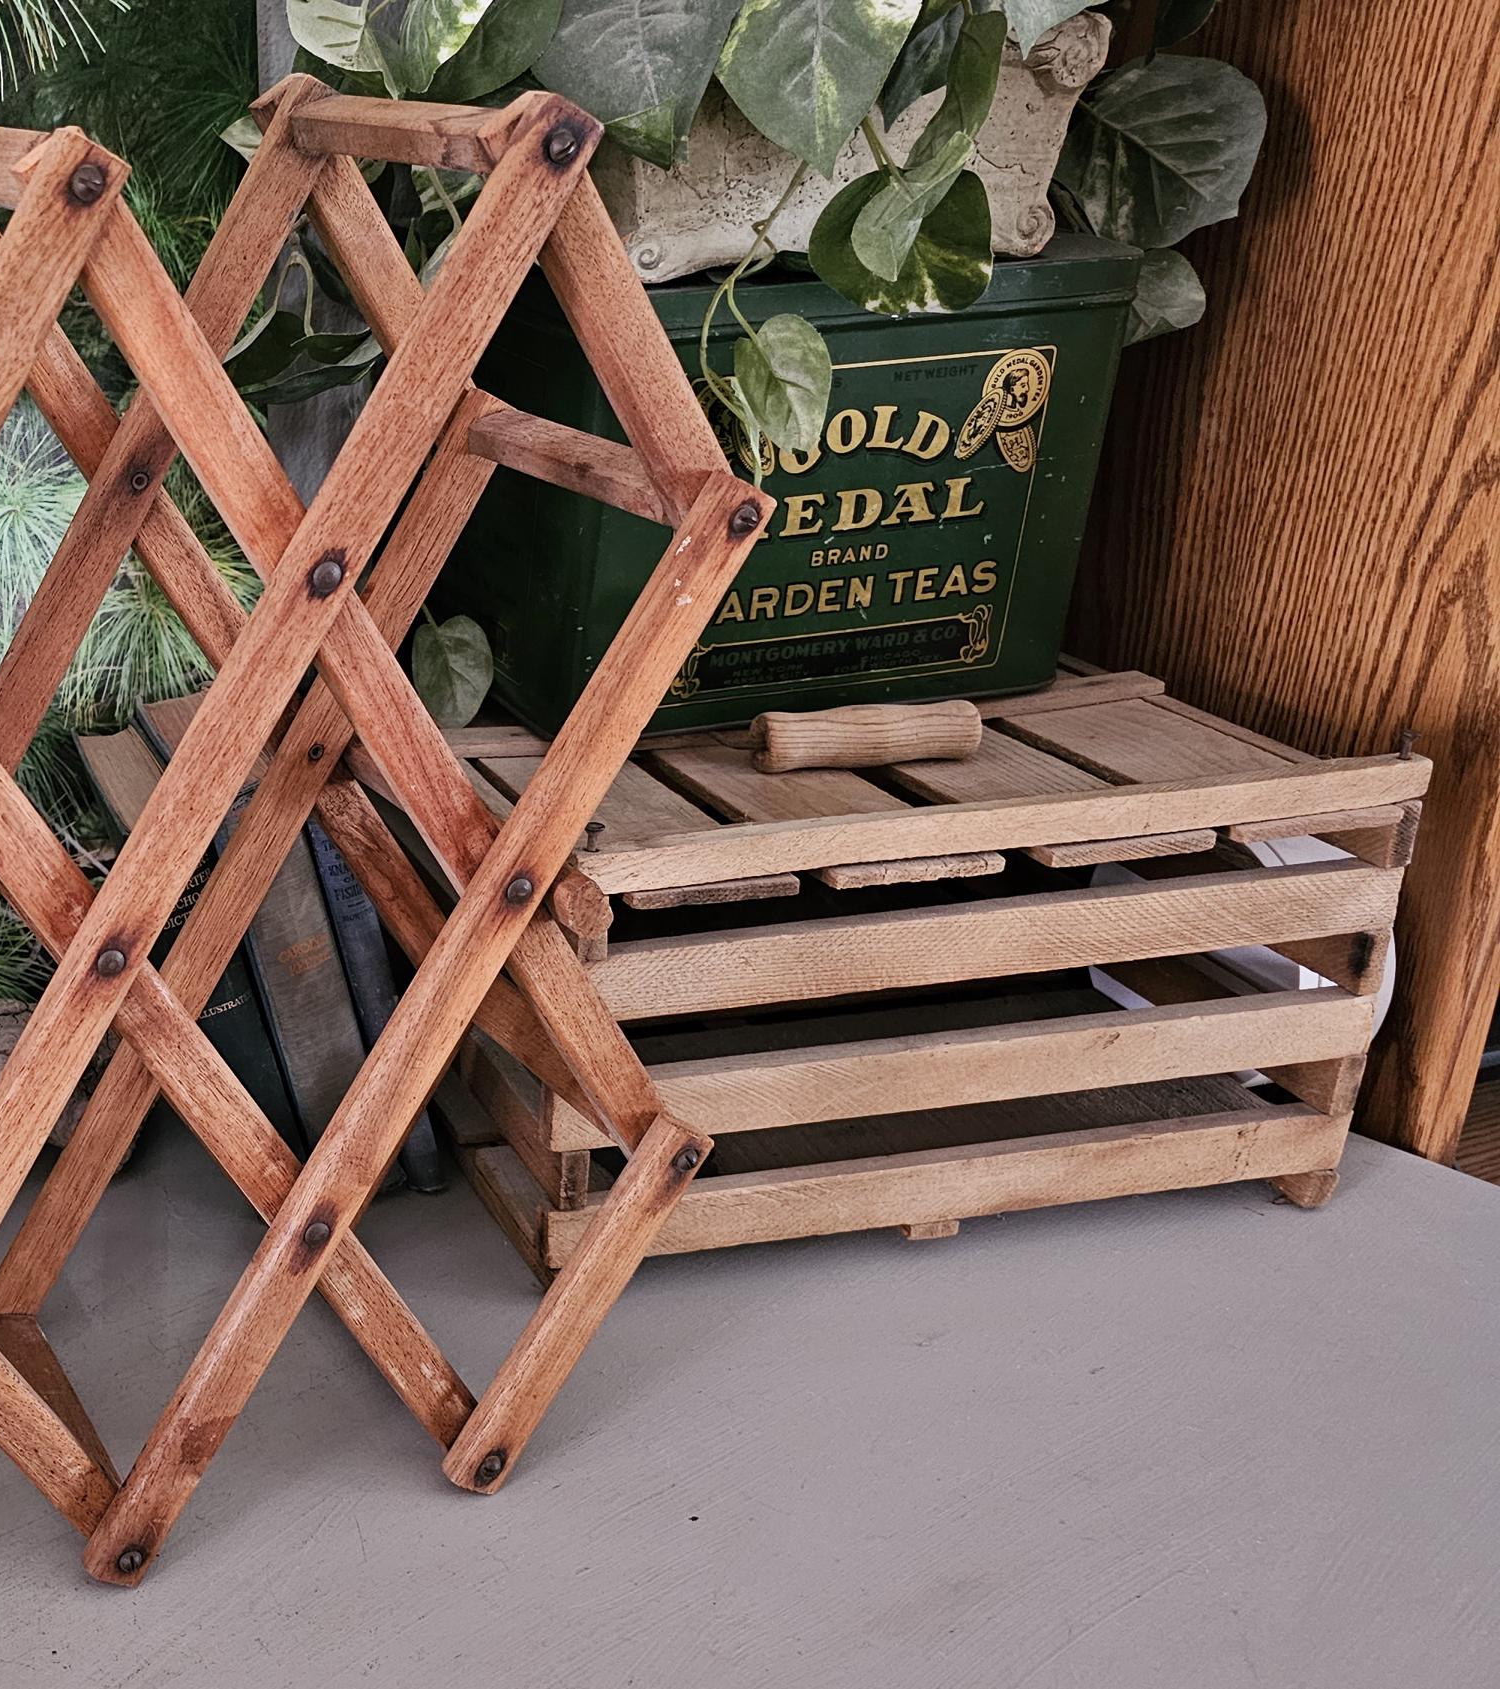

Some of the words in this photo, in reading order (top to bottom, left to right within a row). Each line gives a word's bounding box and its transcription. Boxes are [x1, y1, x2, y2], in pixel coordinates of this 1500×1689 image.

[894, 369, 922, 382] NET
[924, 364, 979, 380] WEIGHT
[991, 368, 1005, 389] GOLD
[1006, 357, 1029, 368] MEDAL
[758, 477, 985, 540] EDAL
[810, 543, 890, 568] BRAND
[714, 575, 875, 626] ARDEN
[888, 560, 998, 604] TEAS
[709, 638, 852, 668] MONTGOMERY
[855, 630, 910, 651] WARD
[913, 628, 930, 644] &
